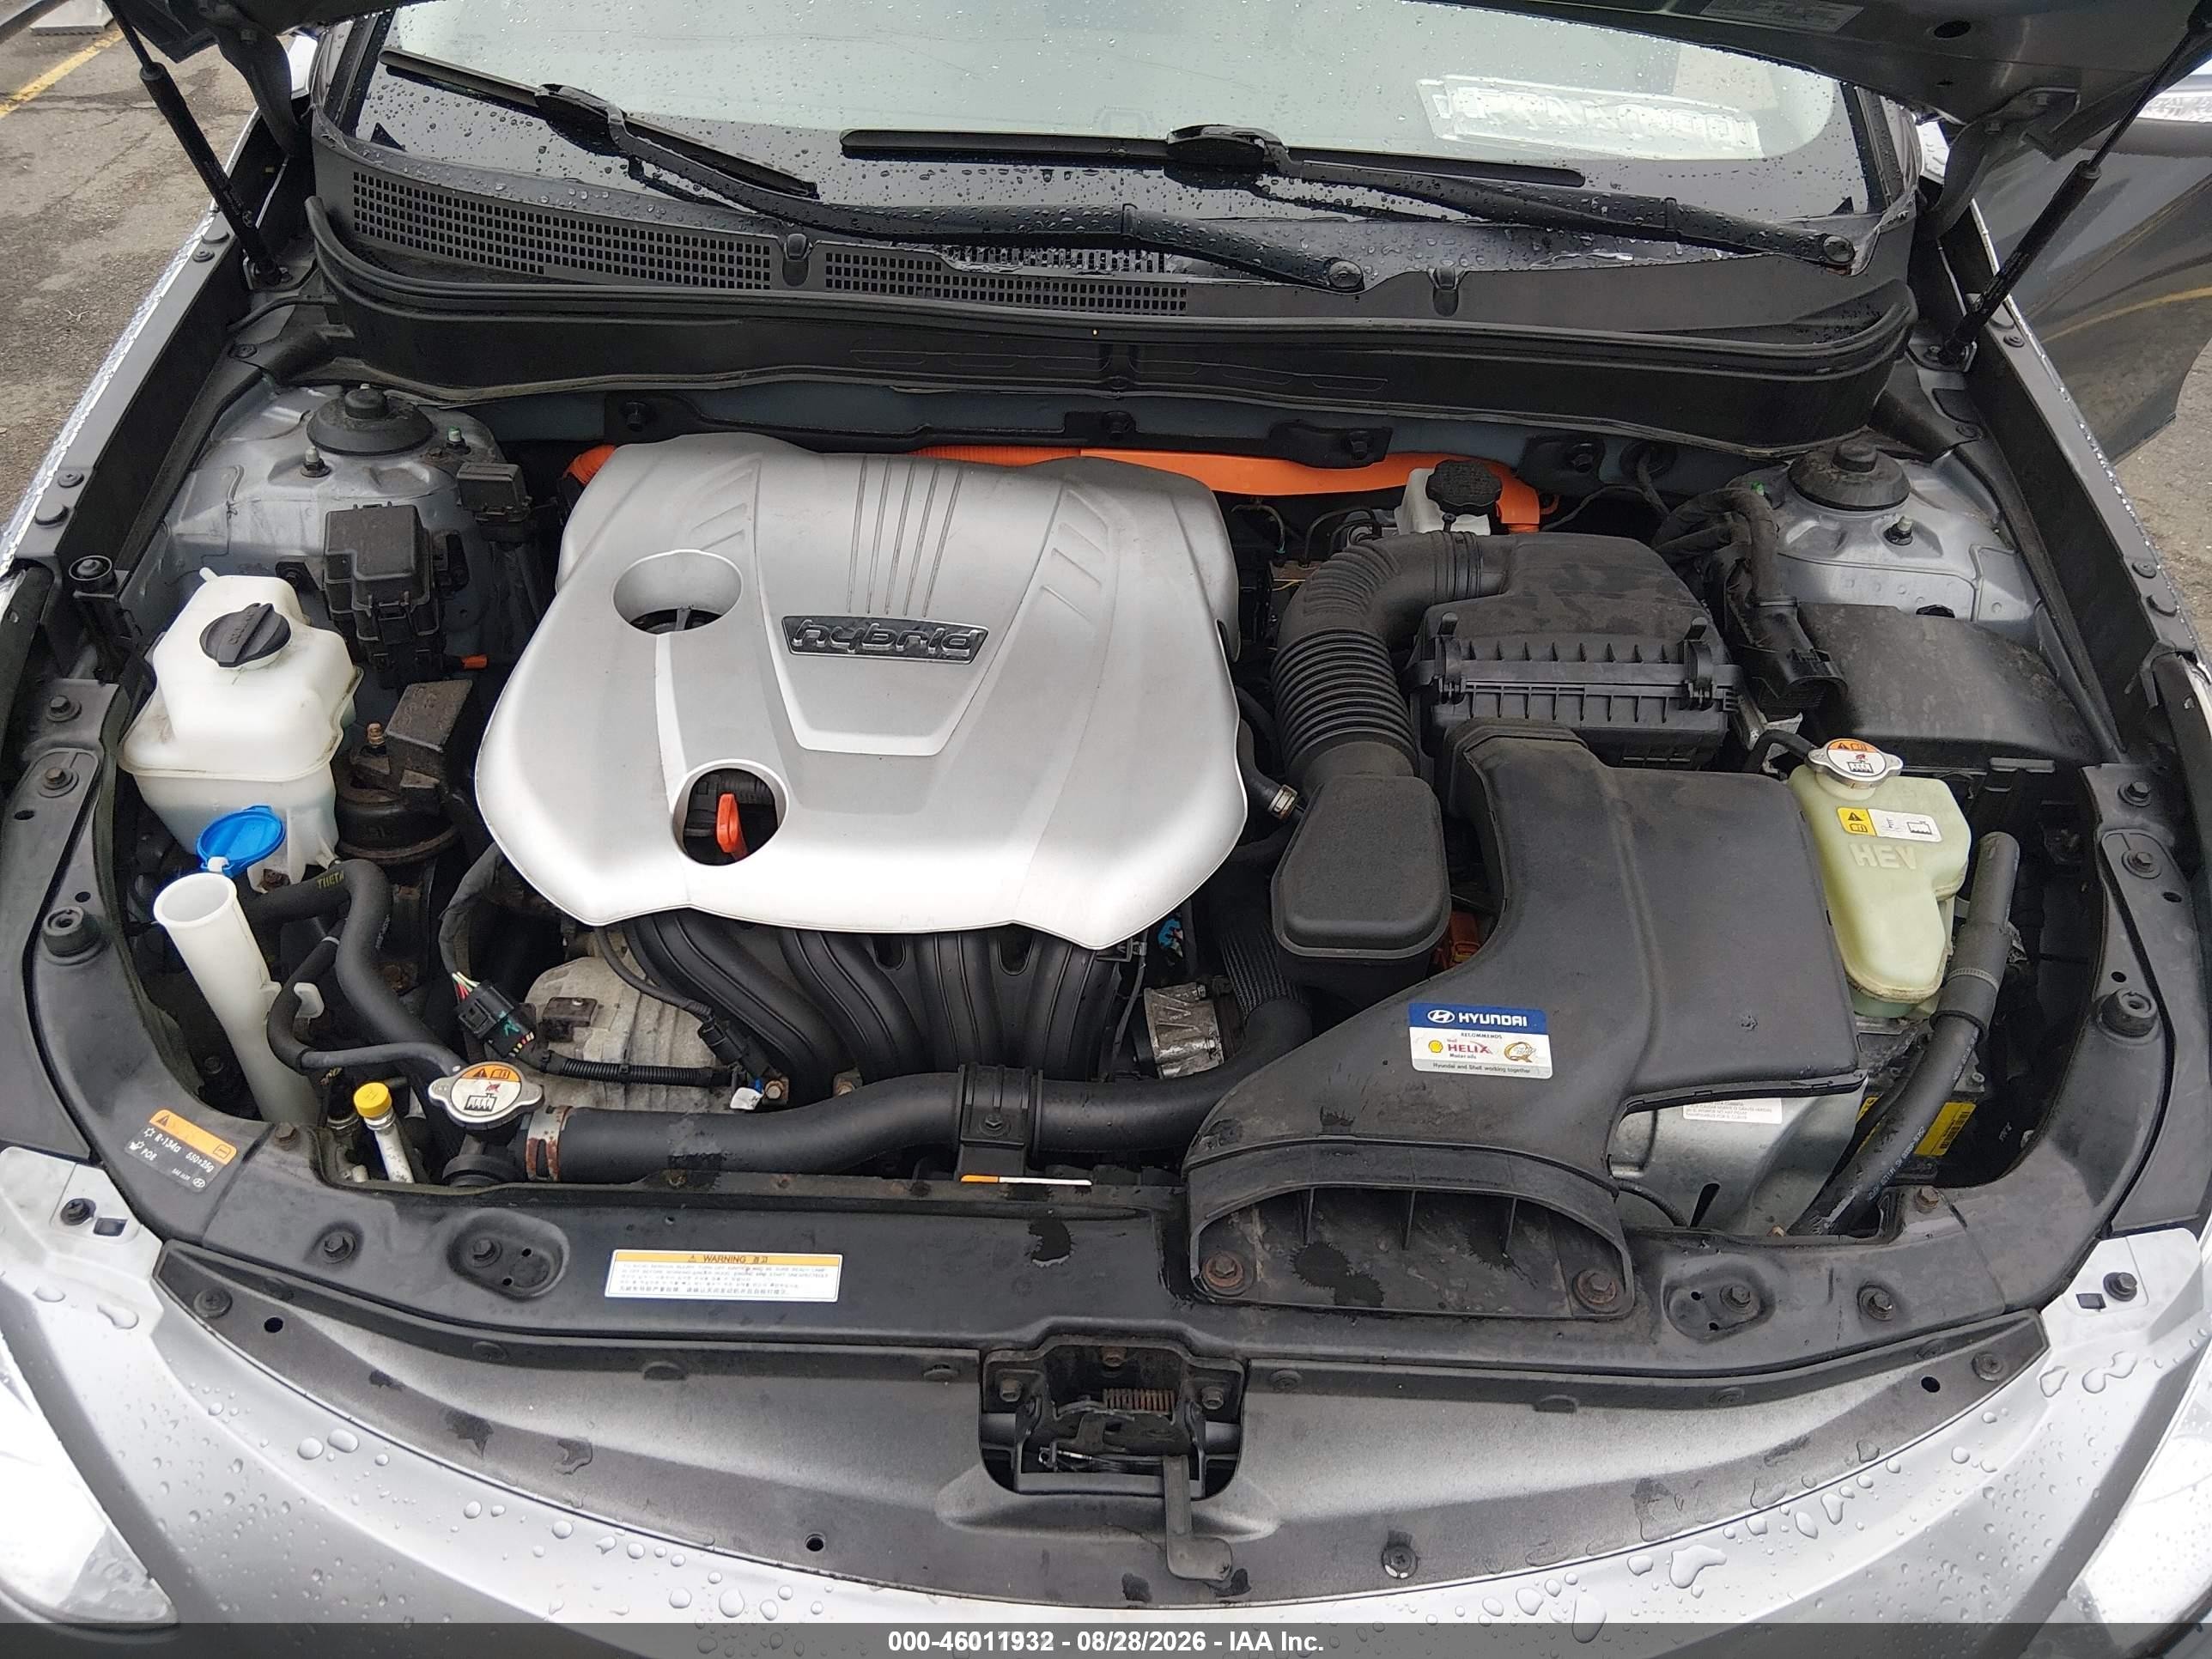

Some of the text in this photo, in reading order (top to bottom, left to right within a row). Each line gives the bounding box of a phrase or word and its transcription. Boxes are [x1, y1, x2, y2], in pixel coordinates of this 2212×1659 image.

[792, 618, 985, 658] hybrid
[1849, 843, 1917, 870] HEV
[1459, 1012, 1528, 1027] HYUNDAI
[1448, 1042, 1492, 1054] HELIX
[140, 1148, 158, 1161] POE
[704, 1254, 746, 1264] WARNING
